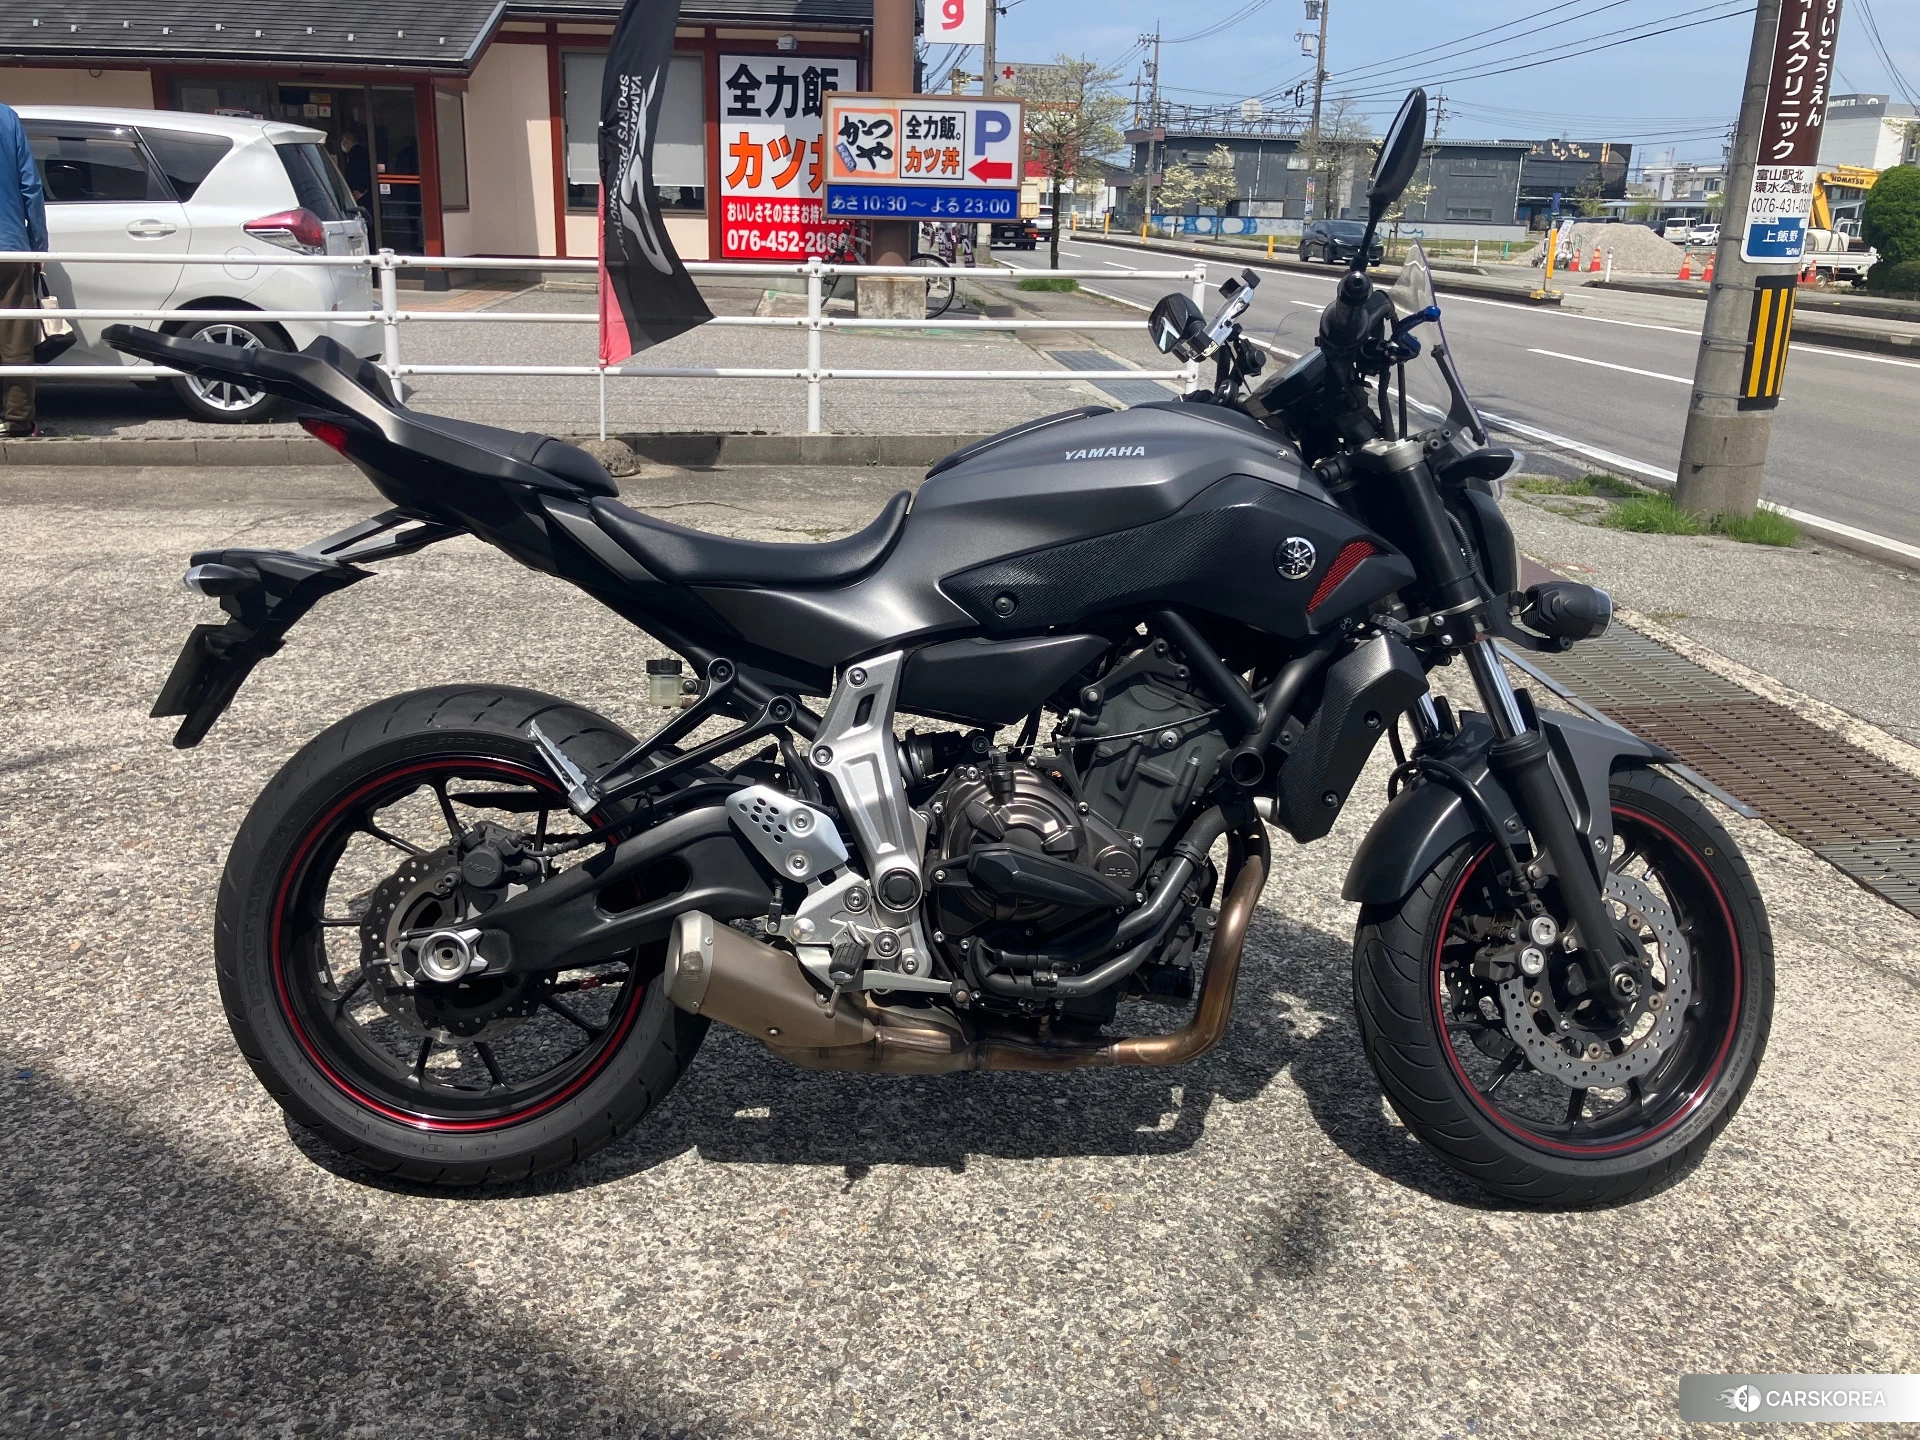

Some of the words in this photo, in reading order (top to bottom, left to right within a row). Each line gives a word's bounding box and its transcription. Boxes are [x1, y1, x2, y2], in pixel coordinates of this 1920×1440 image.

[725, 63, 839, 119] 全力飯
[974, 109, 1012, 156] P
[904, 145, 960, 175] カツ丼
[1757, 168, 1804, 180] 富山駅北
[1831, 175, 1865, 185] KOMATSU
[862, 195, 907, 212] 10:30
[964, 198, 1011, 214] 23:00
[1762, 229, 1799, 242] 上飯野
[1065, 446, 1146, 461] YAMAHA
